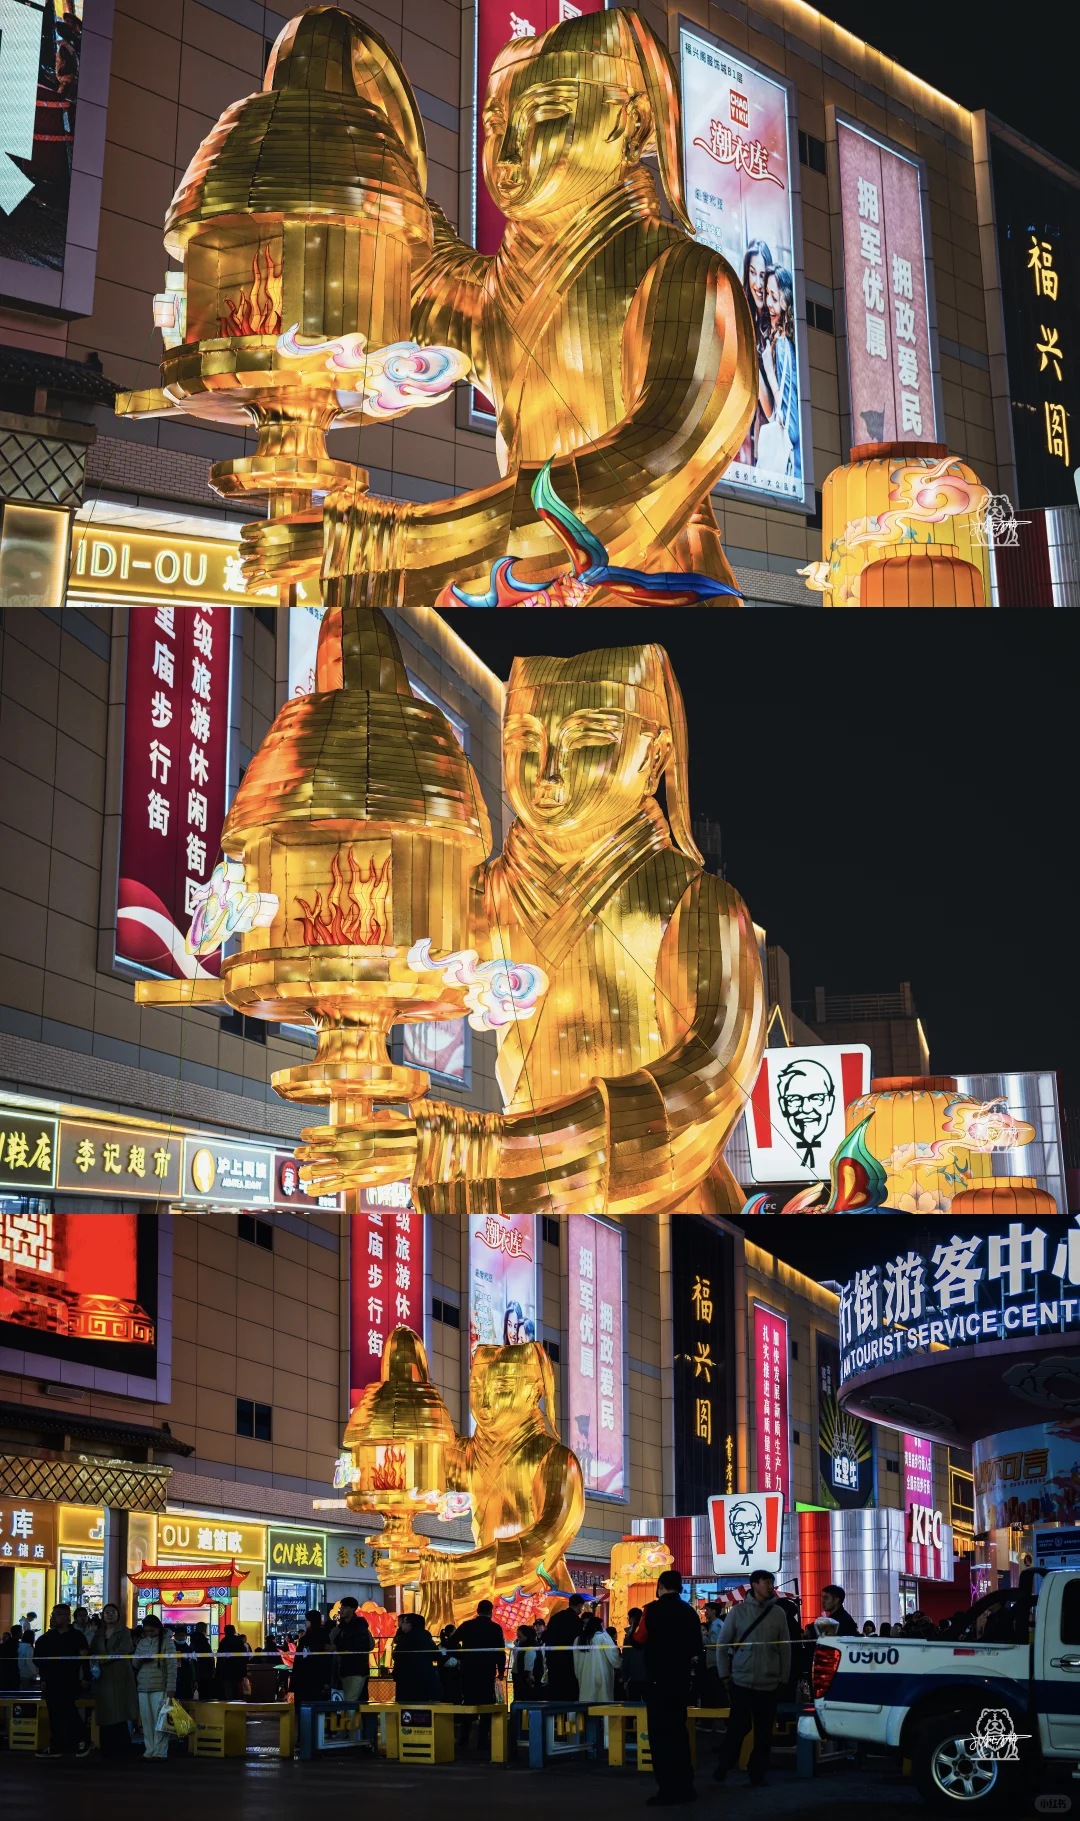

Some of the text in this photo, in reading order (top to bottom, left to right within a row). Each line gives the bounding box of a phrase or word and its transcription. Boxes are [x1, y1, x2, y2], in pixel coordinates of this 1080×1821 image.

[730, 93, 748, 110] CHAO
[730, 107, 749, 124] YIKU
[693, 119, 785, 190] 潮衣库
[857, 176, 888, 361] 拥军优属
[892, 253, 923, 437] 拥政爱民
[1027, 235, 1070, 468] 福兴阁
[75, 1138, 172, 1179] 李记超市
[395, 1214, 411, 1328] 级旅游休
[475, 1216, 533, 1262] 潮衣库
[579, 1246, 594, 1379] 拥军优属
[850, 1331, 905, 1371] TOURIST
[906, 1309, 998, 1350] SERVICE
[600, 1300, 615, 1432] 拥政爱民
[691, 1275, 714, 1446] 福兴阁
[2, 1542, 45, 1558] 仓储店
[197, 1527, 242, 1553] 迪笛欧
[911, 1503, 943, 1549] KFC
